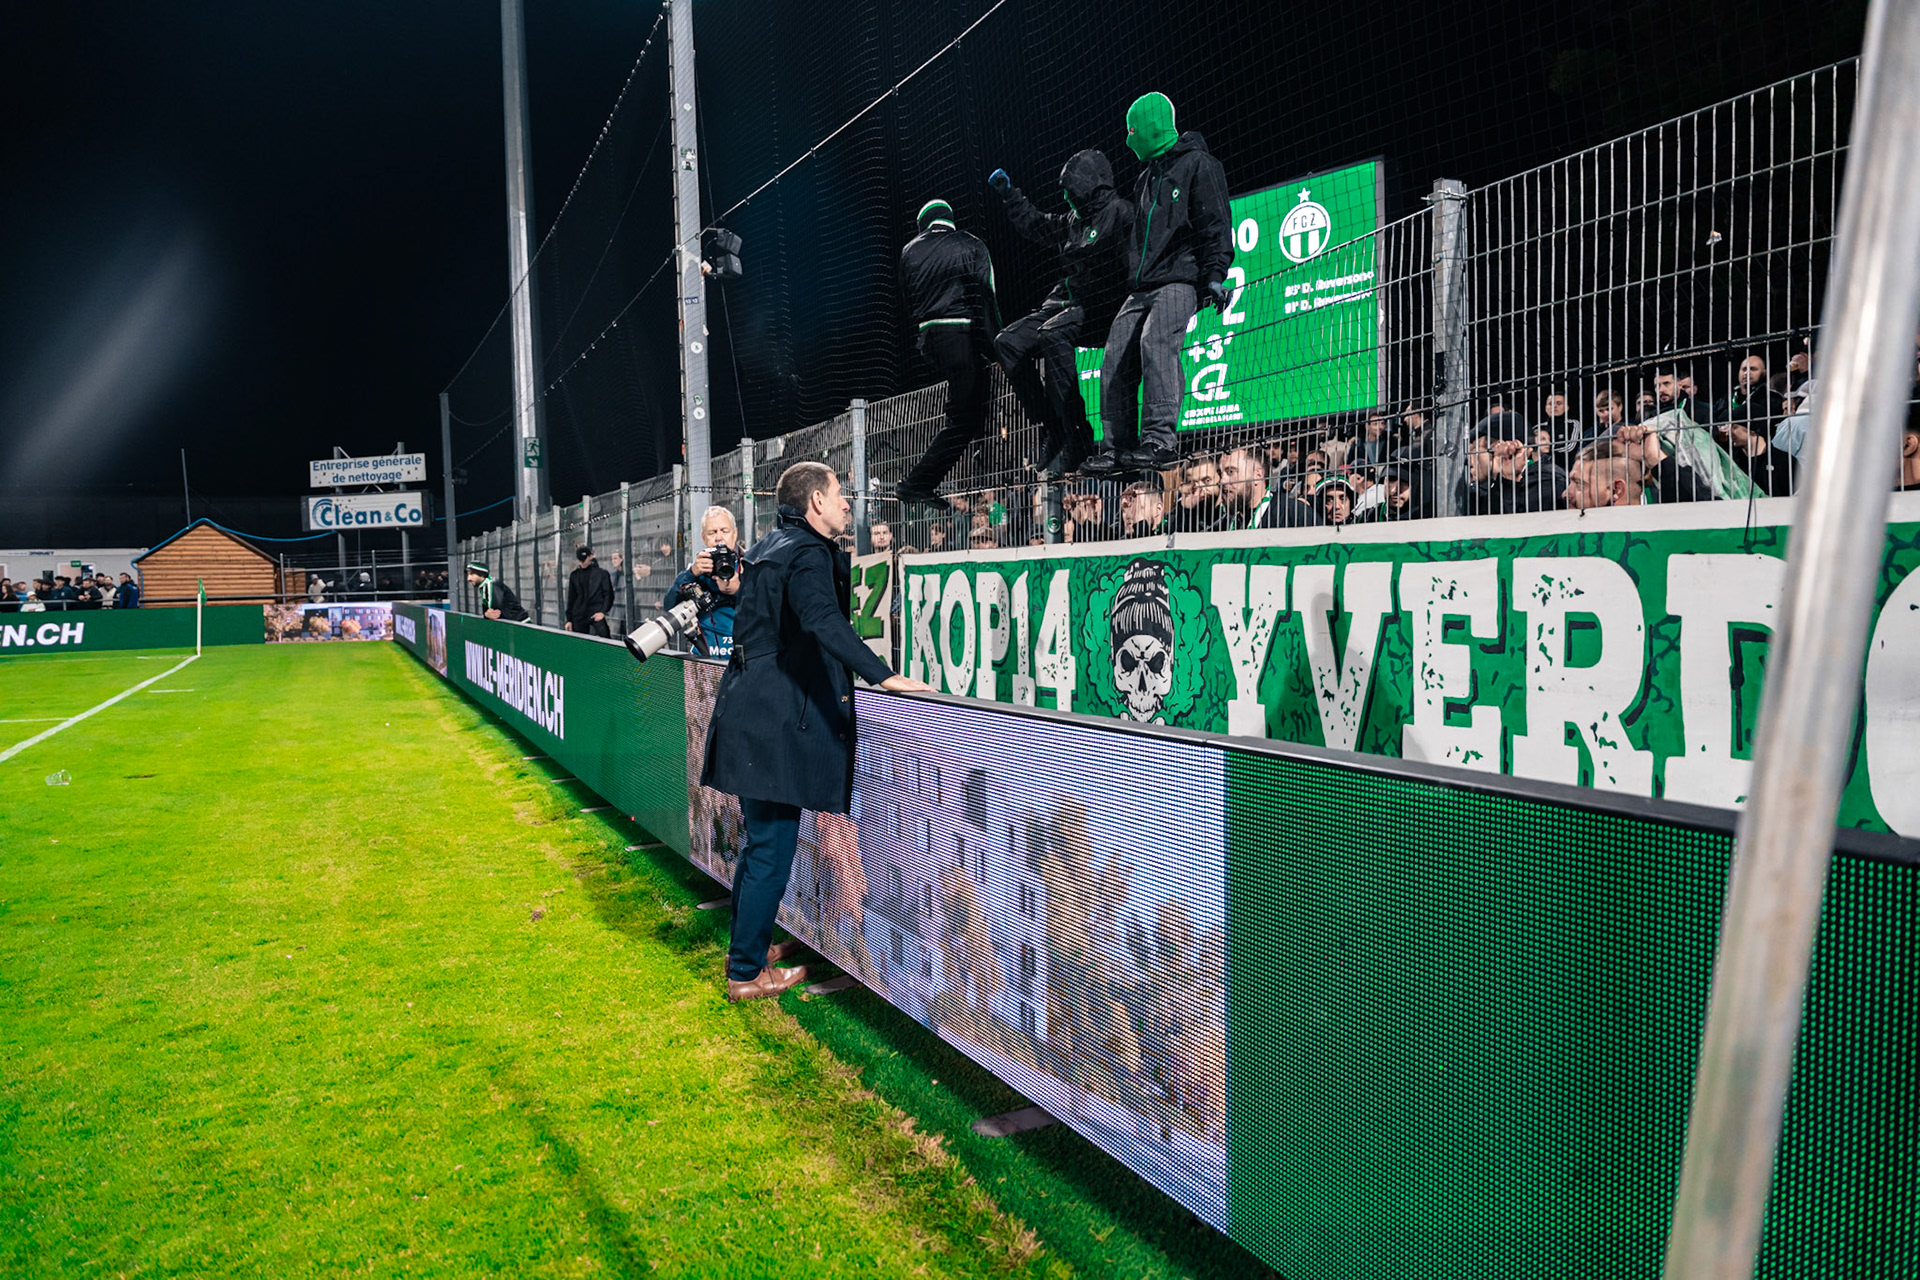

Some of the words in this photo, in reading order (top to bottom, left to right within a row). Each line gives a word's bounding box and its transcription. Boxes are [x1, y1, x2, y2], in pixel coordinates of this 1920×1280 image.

[1293, 213, 1316, 230] FCZ
[1231, 217, 1259, 252] 0
[312, 459, 370, 472] Entreprise
[371, 455, 422, 470] générale
[332, 473, 346, 483] de
[348, 471, 402, 483] nettoyage
[319, 503, 382, 527] Clean
[384, 511, 393, 522] &
[394, 502, 423, 523] Co
[0, 622, 85, 647] N.CH
